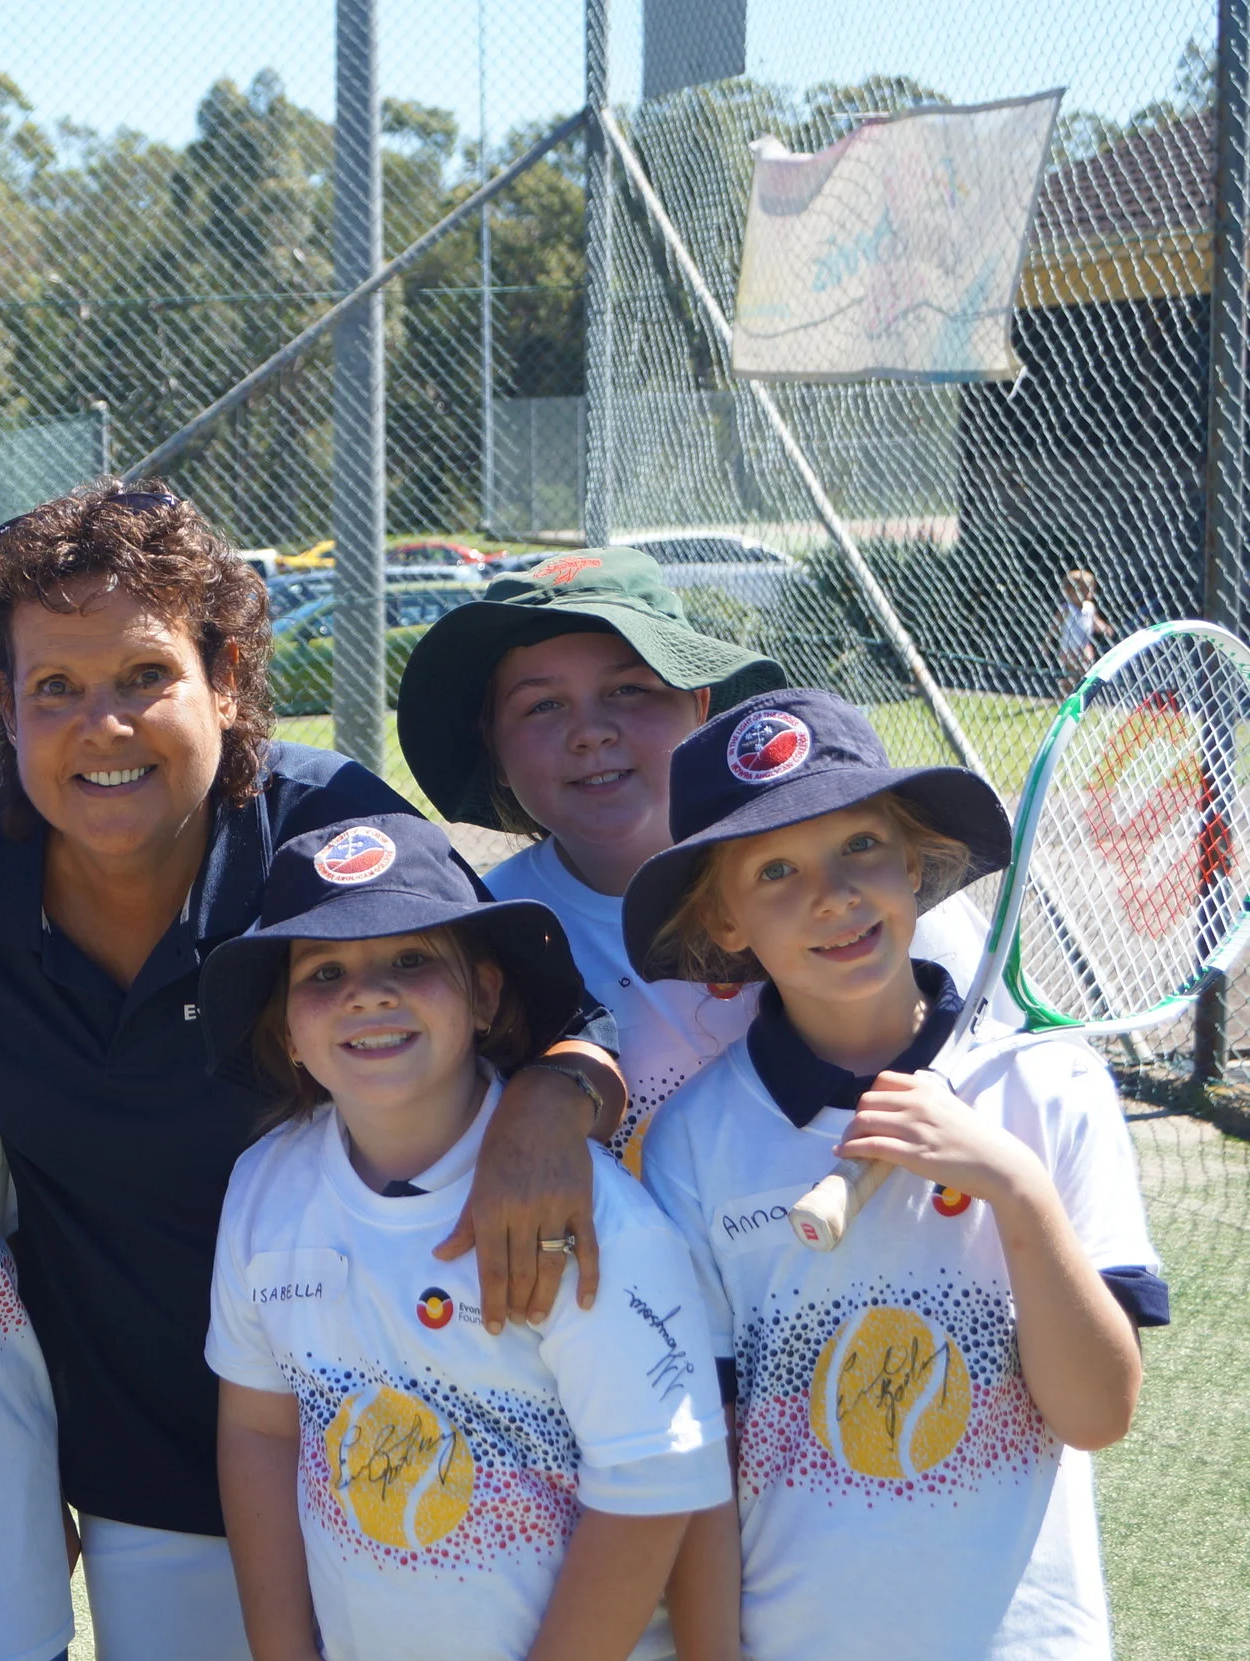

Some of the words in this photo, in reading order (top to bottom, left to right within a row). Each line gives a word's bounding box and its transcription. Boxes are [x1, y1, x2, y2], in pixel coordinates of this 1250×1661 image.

[737, 720, 752, 734] LIGHT
[183, 1003, 201, 1021] E
[722, 1205, 787, 1241] Anna
[252, 1282, 324, 1303] ISABELLA
